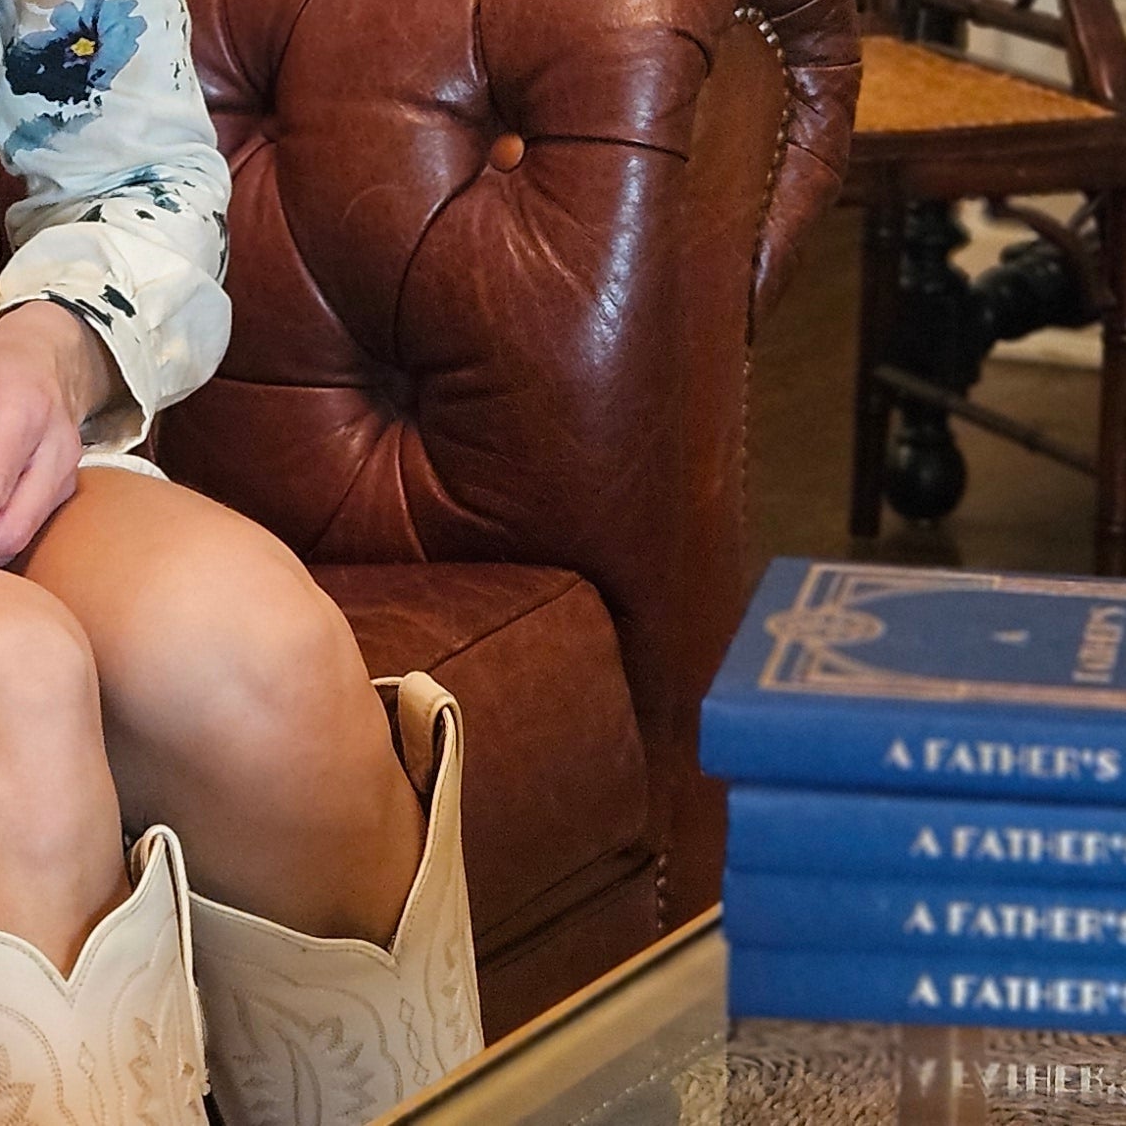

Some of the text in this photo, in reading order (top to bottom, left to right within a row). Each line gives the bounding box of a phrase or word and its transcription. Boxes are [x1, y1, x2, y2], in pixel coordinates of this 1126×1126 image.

[884, 738, 1121, 782] A FATHER'S
[910, 826, 1126, 866] A FATHER'
[903, 901, 935, 934] A
[908, 975, 1126, 1014] A FATHER'
